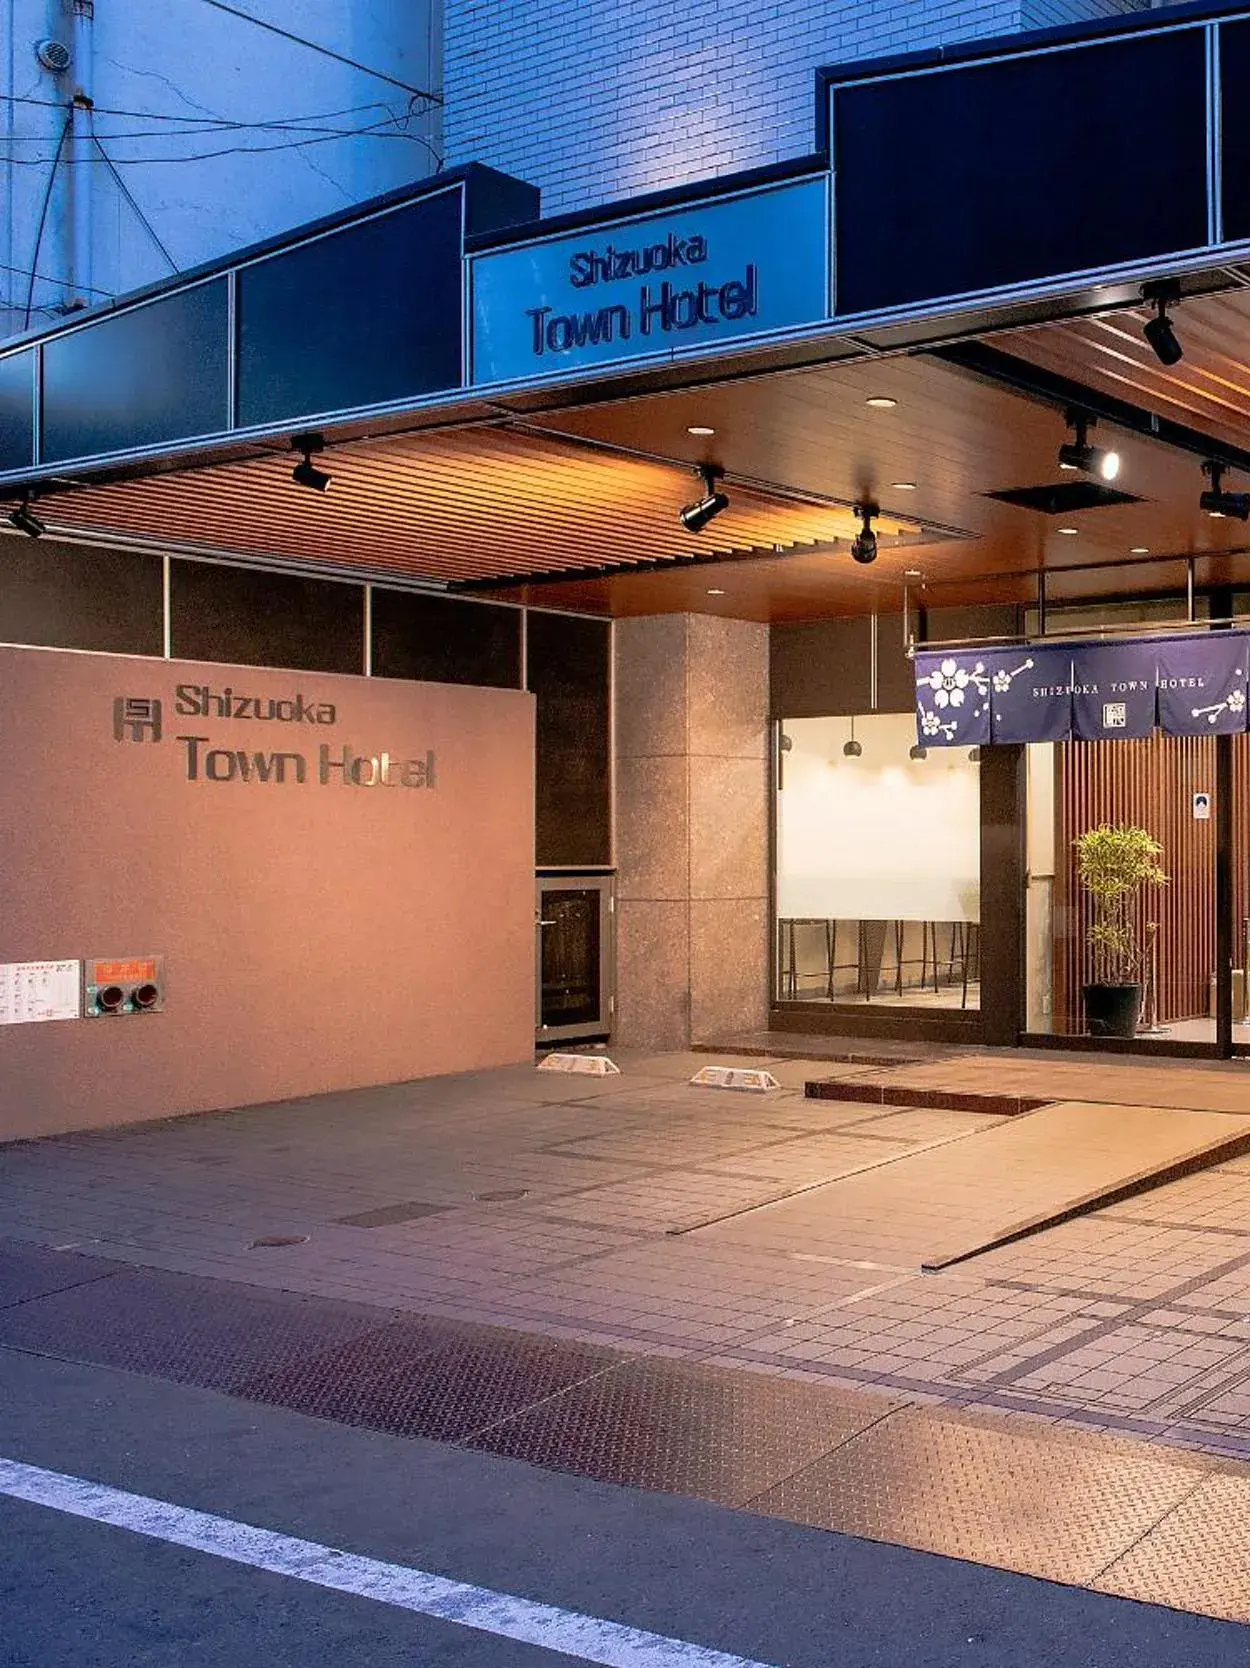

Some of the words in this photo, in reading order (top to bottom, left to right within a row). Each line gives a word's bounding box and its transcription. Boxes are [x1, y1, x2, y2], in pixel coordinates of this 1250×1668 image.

[569, 232, 708, 288] Shizuoka
[525, 304, 631, 355] Town
[639, 262, 758, 335] Hotel
[175, 684, 337, 725] Shizuoka
[1111, 680, 1149, 692] TOWN
[1160, 677, 1205, 689] HOTEL
[176, 736, 307, 785] Town
[319, 744, 436, 789] Hotel
